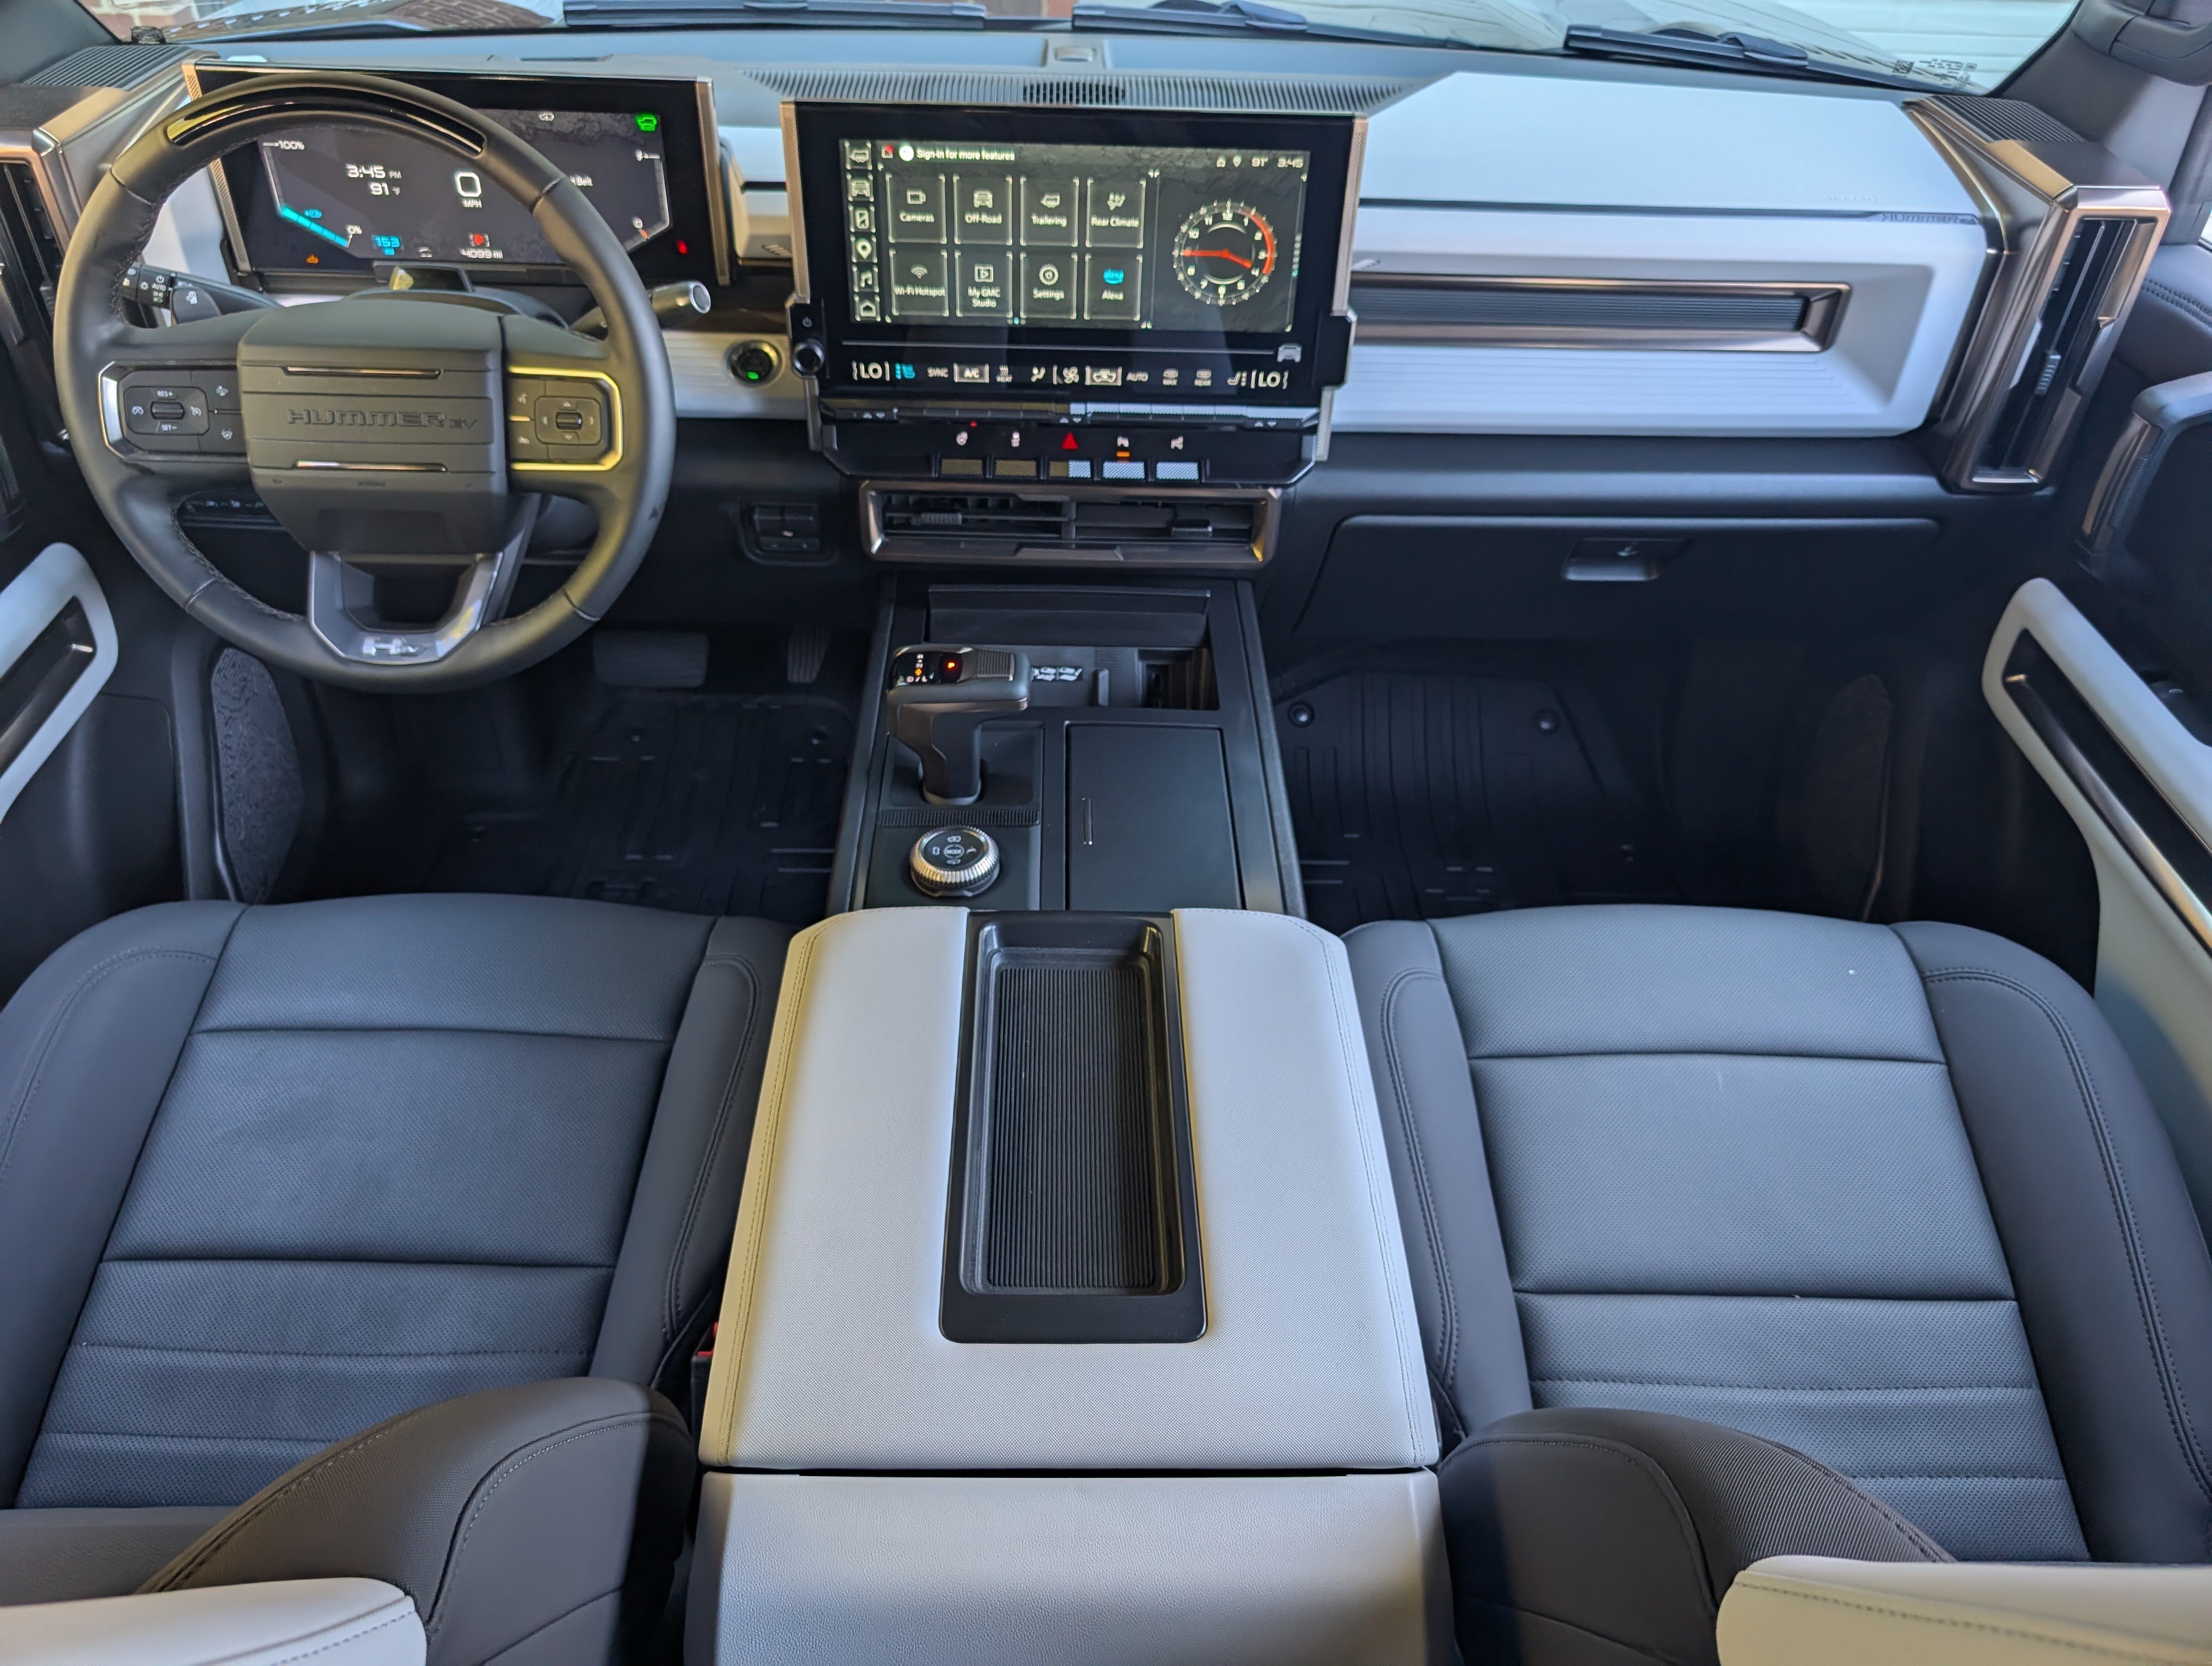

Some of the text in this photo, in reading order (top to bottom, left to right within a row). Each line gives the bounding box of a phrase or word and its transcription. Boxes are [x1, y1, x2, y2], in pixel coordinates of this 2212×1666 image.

[278, 140, 304, 150] 100%
[945, 147, 957, 159] for
[958, 150, 980, 160] more
[981, 148, 1015, 161] features
[346, 163, 385, 178] 3:45
[369, 182, 389, 196] 91
[462, 198, 482, 208] MPH
[152, 283, 166, 292] AUTO
[859, 362, 883, 379] LO
[928, 367, 949, 378] SYNC
[1126, 371, 1149, 382] AUTO
[1258, 371, 1281, 388] LO
[287, 409, 446, 428] HUMMER
